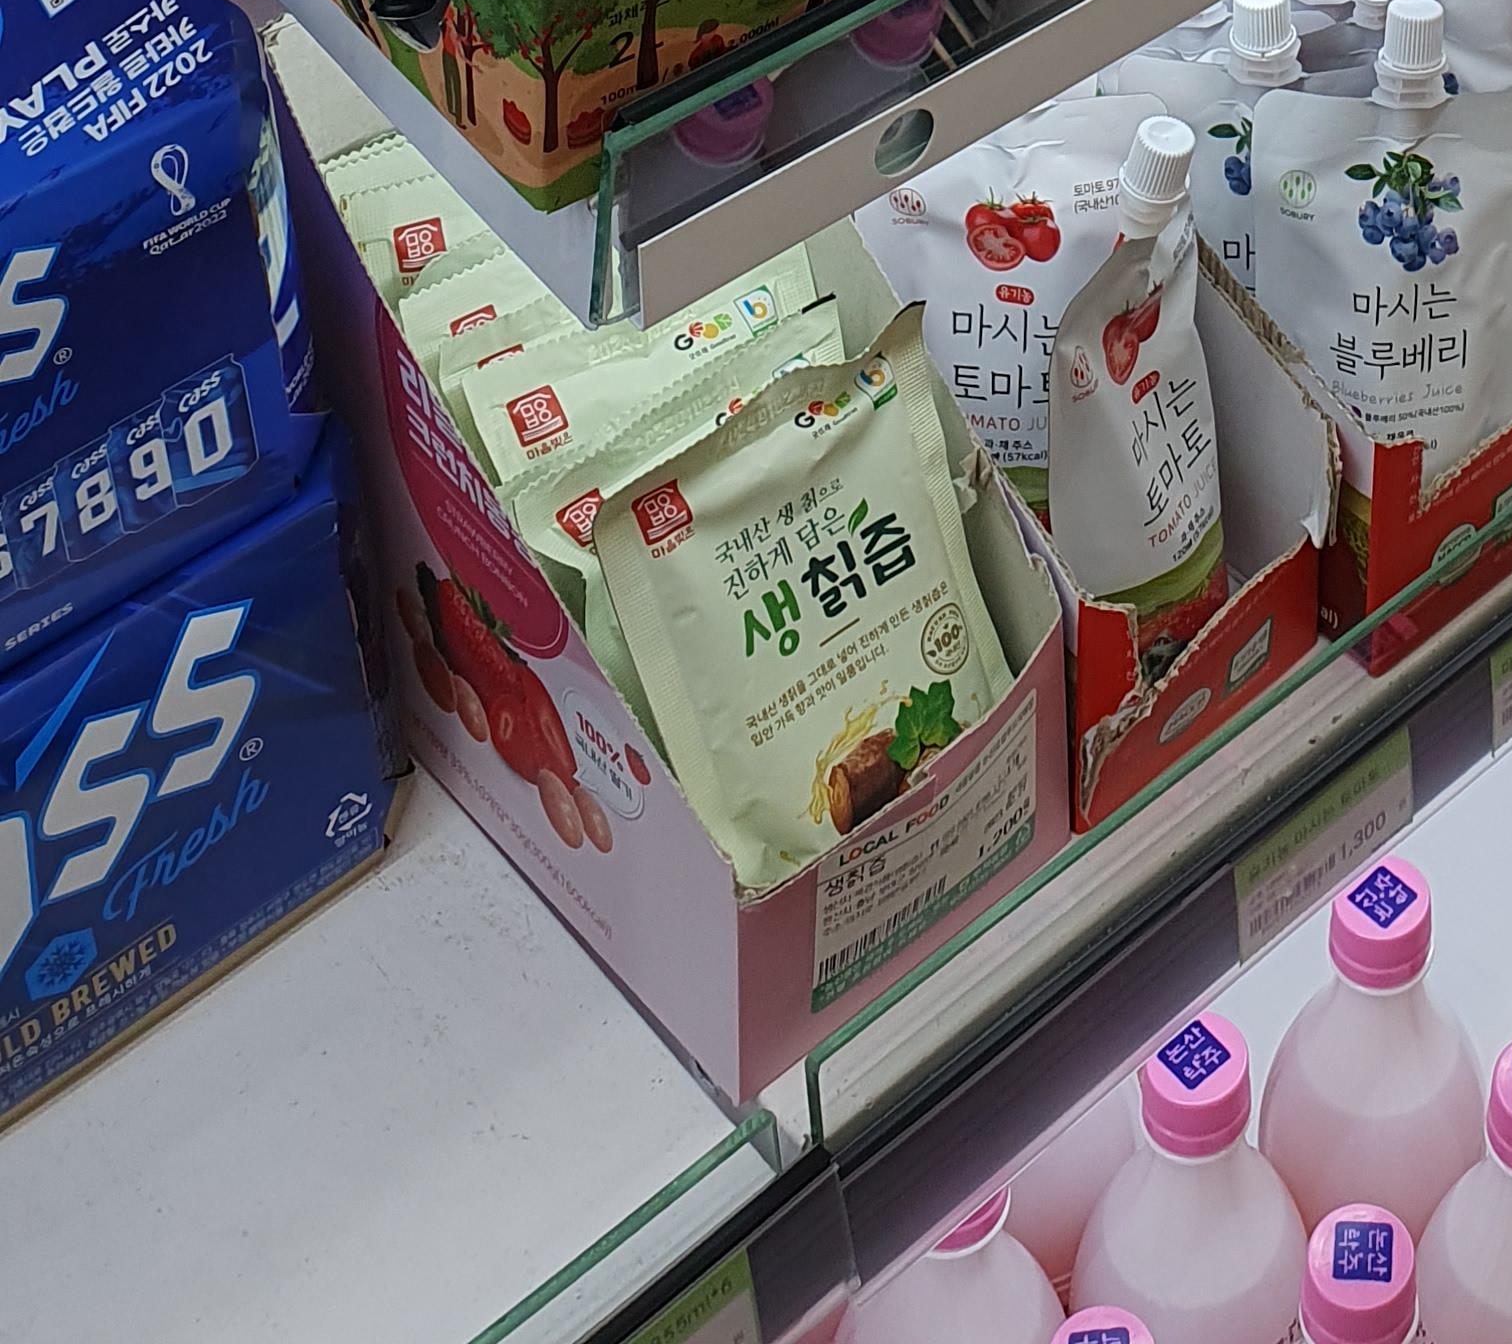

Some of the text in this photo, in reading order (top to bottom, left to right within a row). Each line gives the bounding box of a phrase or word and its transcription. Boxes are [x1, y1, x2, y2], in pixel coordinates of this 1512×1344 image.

[18, 16, 199, 157] 카타르 월드컵은
[83, 39, 213, 142] 2022 FIFA
[1073, 184, 1105, 199] 토마토
[1280, 208, 1317, 223] SOBURY
[143, 197, 231, 250] FIFA WORLD CUP
[997, 287, 1034, 304] 유기농
[1353, 283, 1458, 327] 마시는
[1330, 331, 1468, 380] 블루베리
[1331, 380, 1464, 406] Blueberries Juice
[1010, 440, 1034, 451] 주스
[1132, 379, 1196, 466] 마시는
[20, 396, 233, 556] 7 8 9 0
[1003, 448, 1047, 465] (57kcal)
[1144, 419, 1211, 526] 토마토
[714, 478, 845, 565] 국내산 생 칡으로
[1148, 494, 1192, 547] TOMATO
[722, 505, 846, 601] 진하게 담은
[4, 602, 73, 651] SERIES
[744, 622, 890, 730] 국내산 그대로 넣어 진하게
[750, 645, 890, 748] 입안 가득 향과 맛이 일품입니다.
[575, 709, 627, 773] 100%
[103, 769, 270, 921] Fresh
[840, 794, 950, 866] LOCAL FOOD
[1338, 811, 1387, 860] 1,300
[825, 855, 886, 897] 생칡즙
[51, 922, 178, 1026] BREWED
